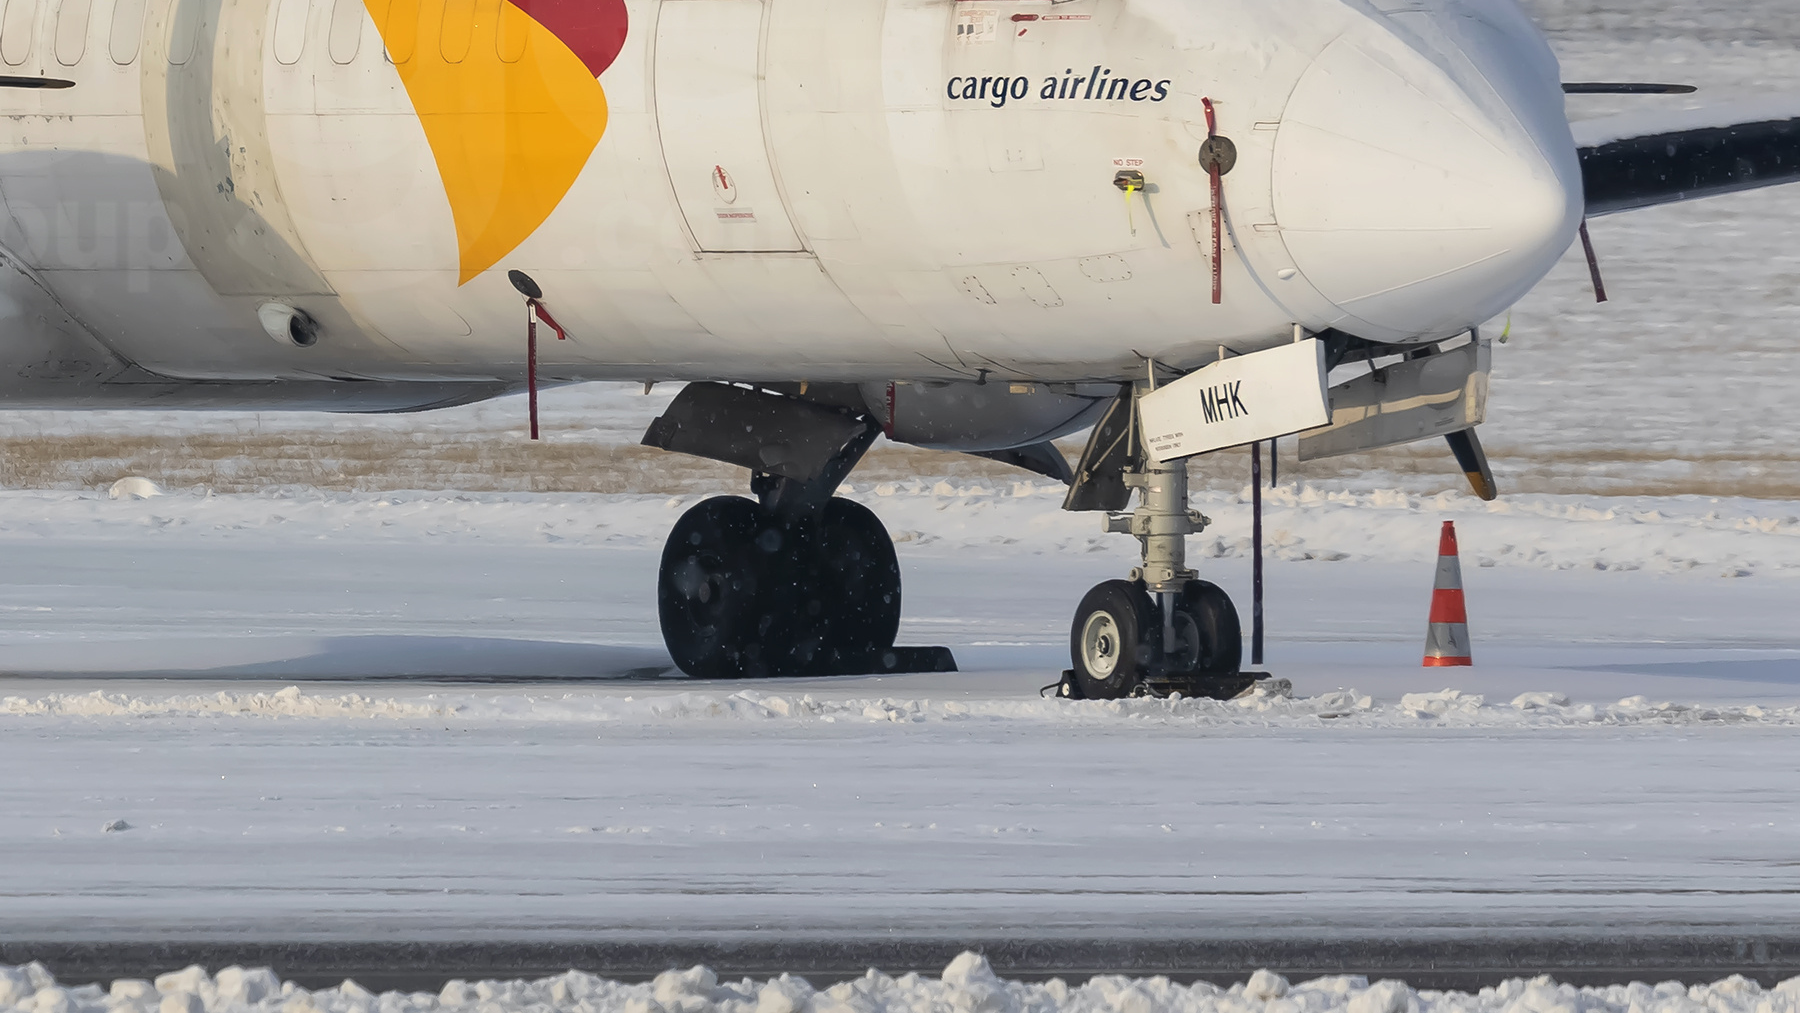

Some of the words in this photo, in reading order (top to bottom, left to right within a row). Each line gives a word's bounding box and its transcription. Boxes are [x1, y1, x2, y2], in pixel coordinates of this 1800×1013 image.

[947, 76, 1029, 108] cargo
[1040, 65, 1171, 102] airlines
[1200, 380, 1248, 424] MHK
